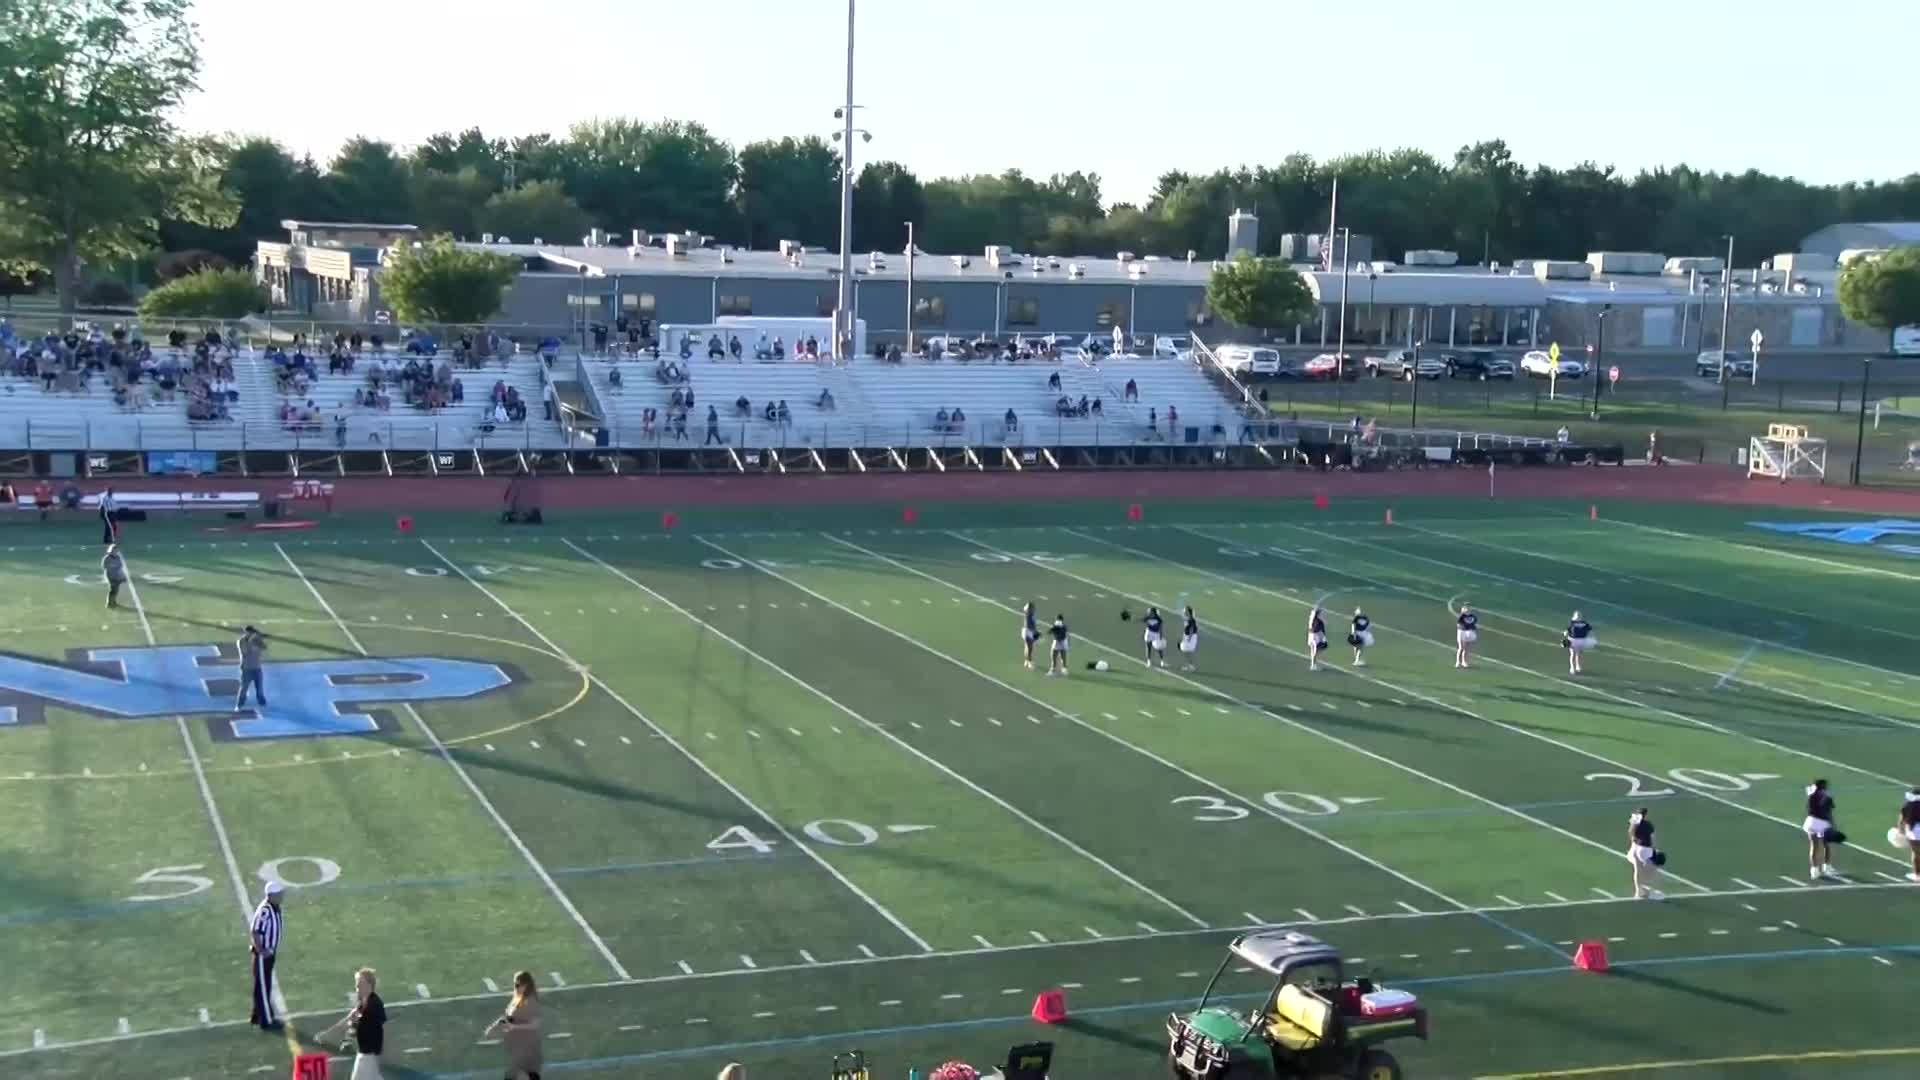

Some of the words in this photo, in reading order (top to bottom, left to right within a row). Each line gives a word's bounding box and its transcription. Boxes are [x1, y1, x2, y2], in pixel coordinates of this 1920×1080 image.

[1583, 767, 1751, 797] 20
[1170, 790, 1340, 822] 30
[705, 818, 879, 852] 40
[126, 855, 342, 902] 50
[299, 1056, 326, 1080] 50
